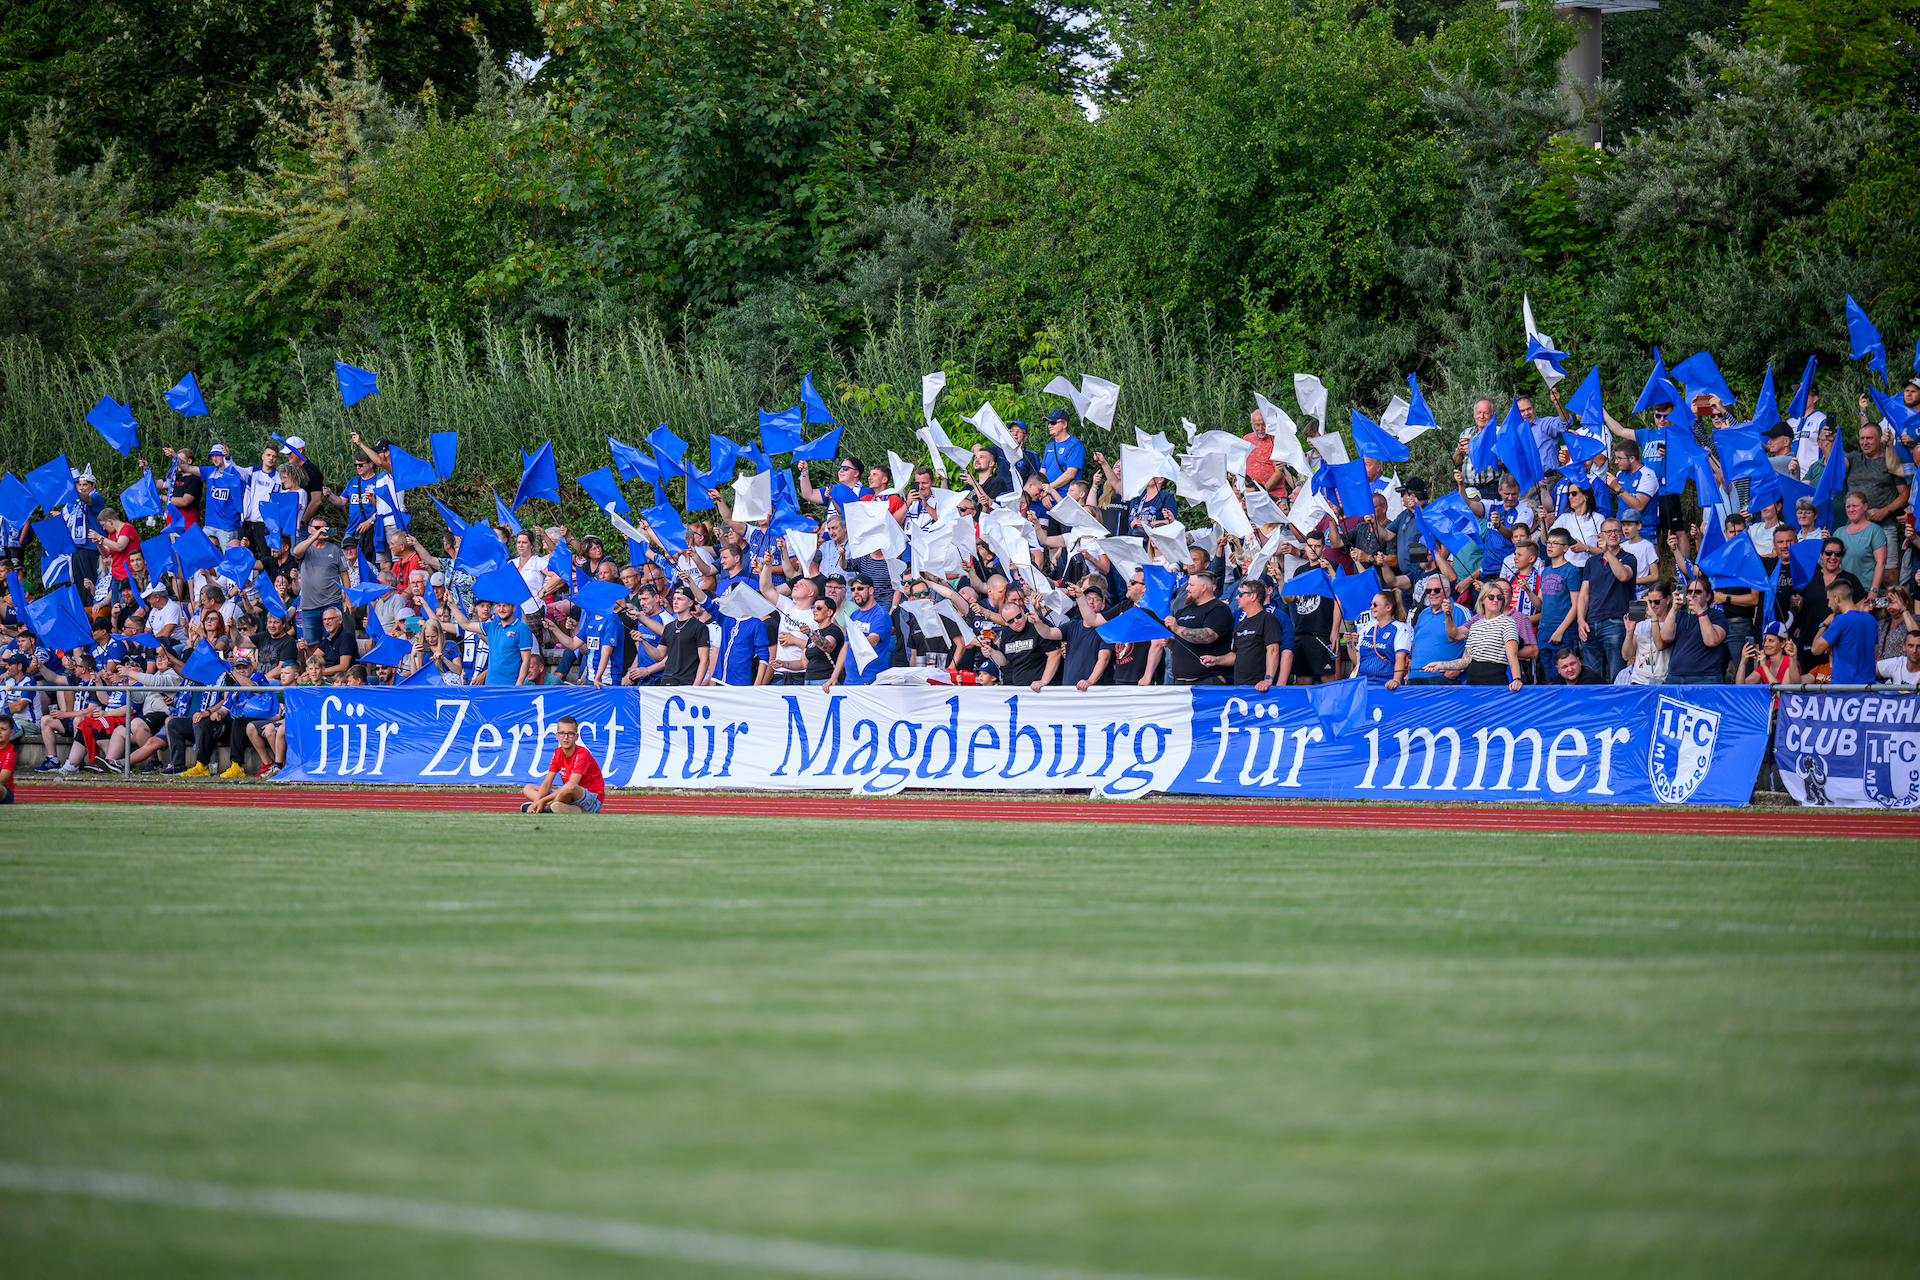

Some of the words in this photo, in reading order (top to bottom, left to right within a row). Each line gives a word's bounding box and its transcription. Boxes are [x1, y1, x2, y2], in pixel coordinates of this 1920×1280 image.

[307, 695, 399, 776] für
[648, 695, 749, 779] für
[770, 695, 1172, 794] Magdeburg
[1195, 697, 1323, 787] für
[1354, 707, 1630, 795] immer
[1662, 709, 1713, 747] 1.FC
[1786, 724, 1858, 756] CLUB
[1868, 738, 1917, 764] 1.FC
[1654, 742, 1707, 800] MAGDEBURG
